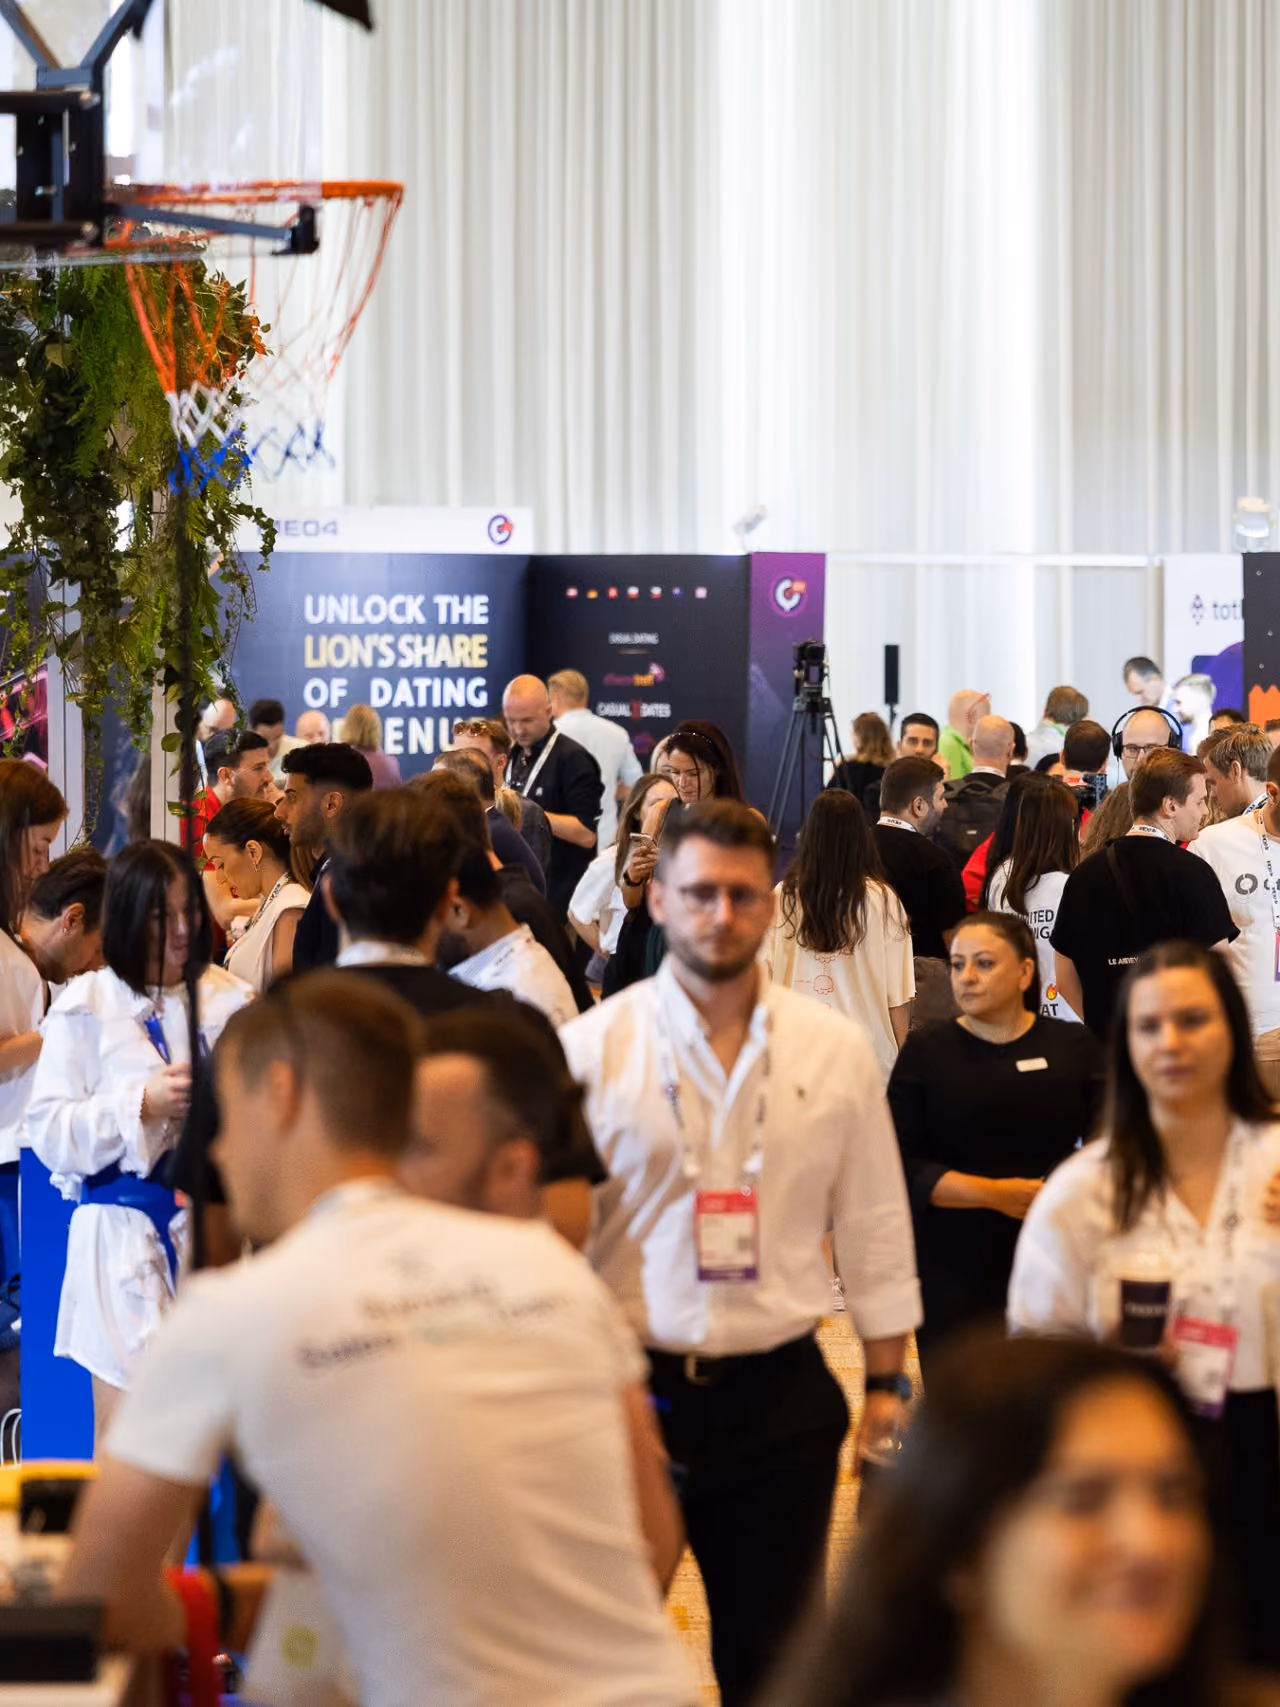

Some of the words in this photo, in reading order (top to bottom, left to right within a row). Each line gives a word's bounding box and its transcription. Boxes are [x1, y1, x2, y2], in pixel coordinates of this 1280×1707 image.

[304, 594, 426, 624] UNLOCK
[433, 594, 489, 624] THE
[304, 634, 395, 668] LION'S
[398, 634, 488, 668] SHARE
[303, 677, 348, 708] OF
[370, 677, 488, 708] DATING
